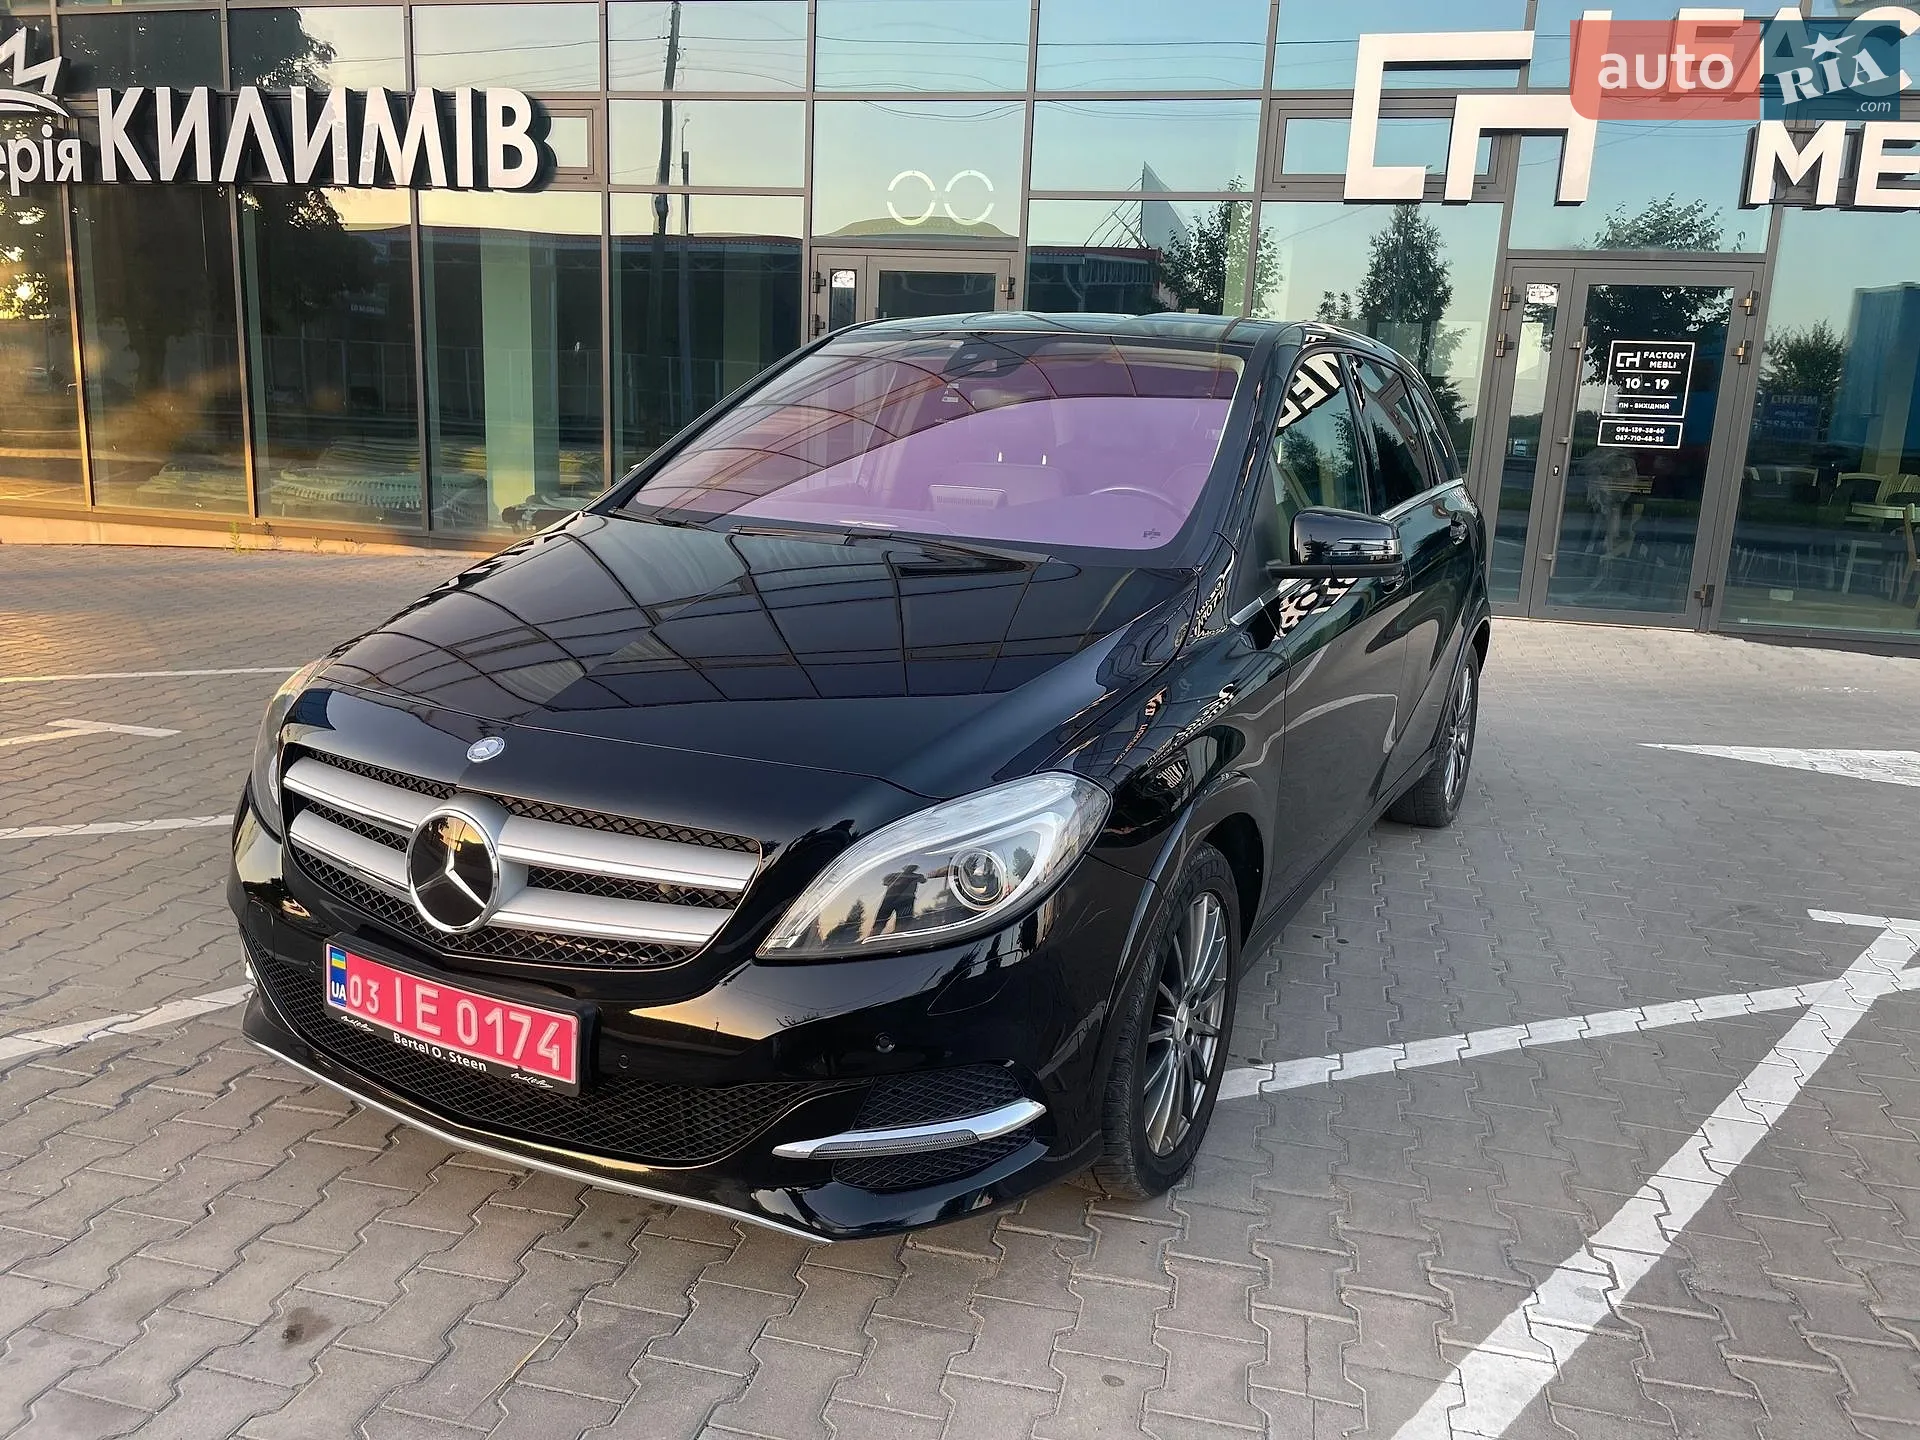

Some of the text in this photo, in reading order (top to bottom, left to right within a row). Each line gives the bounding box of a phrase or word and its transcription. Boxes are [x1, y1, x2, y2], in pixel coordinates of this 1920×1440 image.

[97, 85, 540, 190] КИЛИМІВ
[0, 124, 83, 196] рія
[1643, 351, 1687, 360] FACTORY
[1649, 361, 1677, 369] MEBLI
[1625, 378, 1641, 389] 10
[1655, 379, 1670, 390] 19
[331, 980, 347, 1001] UA
[349, 974, 380, 1015] 03
[456, 998, 561, 1072] 0174
[393, 1031, 487, 1073] Bertel O. Steen
